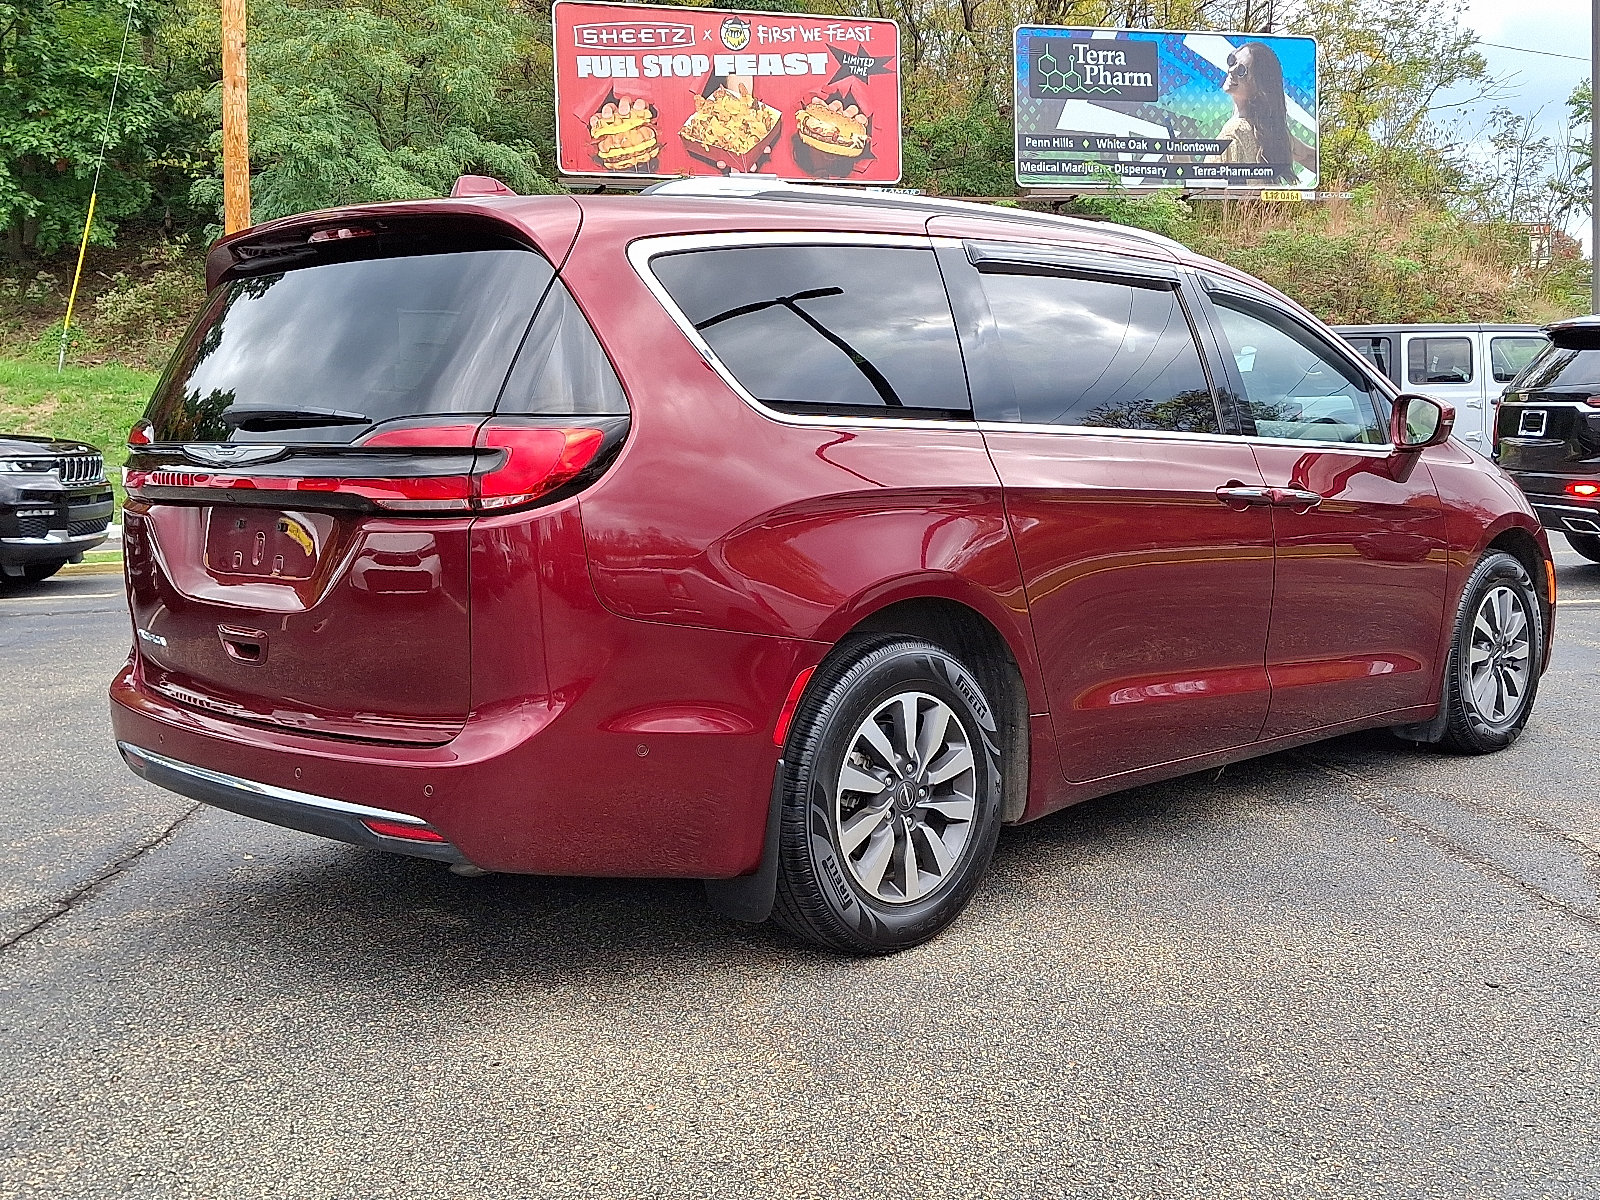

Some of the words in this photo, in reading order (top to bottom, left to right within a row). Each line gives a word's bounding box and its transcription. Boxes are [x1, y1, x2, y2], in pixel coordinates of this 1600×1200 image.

[582, 28, 687, 44] SHEETZ
[757, 24, 797, 45] FIRST
[799, 25, 823, 42] WE
[823, 23, 873, 43] FEAST
[576, 55, 640, 78] FUEL
[642, 54, 710, 78] STOP
[713, 53, 829, 77] FEAST
[842, 54, 875, 67] LIMITED
[1073, 43, 1127, 66] Terra
[849, 65, 868, 76] TIME
[1084, 64, 1153, 87] Pharm
[1025, 136, 1051, 148] Penn
[1052, 138, 1074, 148] Hills
[1096, 138, 1126, 149] White
[1127, 139, 1148, 150] Oak
[1166, 141, 1220, 152] Uniontown
[1020, 161, 1060, 172] Medical
[1114, 164, 1168, 177] Dispensary
[1192, 166, 1274, 177] Terra-Pharm.com
[955, 673, 988, 719] PIRELLI
[821, 854, 853, 911] PIRELLI
